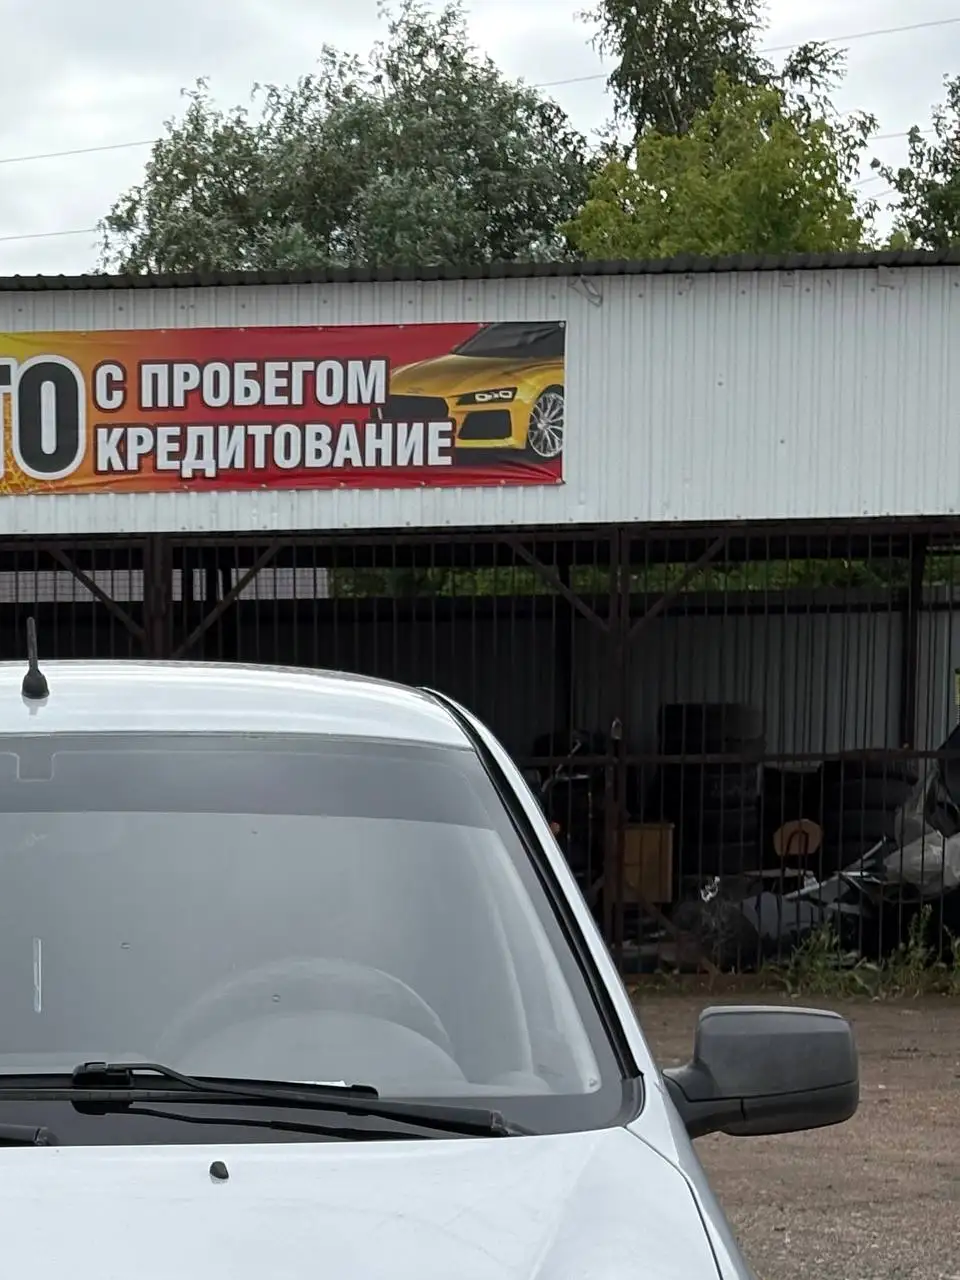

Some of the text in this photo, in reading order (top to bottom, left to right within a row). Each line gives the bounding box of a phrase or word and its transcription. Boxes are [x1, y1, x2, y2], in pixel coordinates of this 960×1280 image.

[94, 359, 387, 410] С ПРОБЕГОМ
[95, 421, 454, 479] КРЕДИТОВАНИЕ
